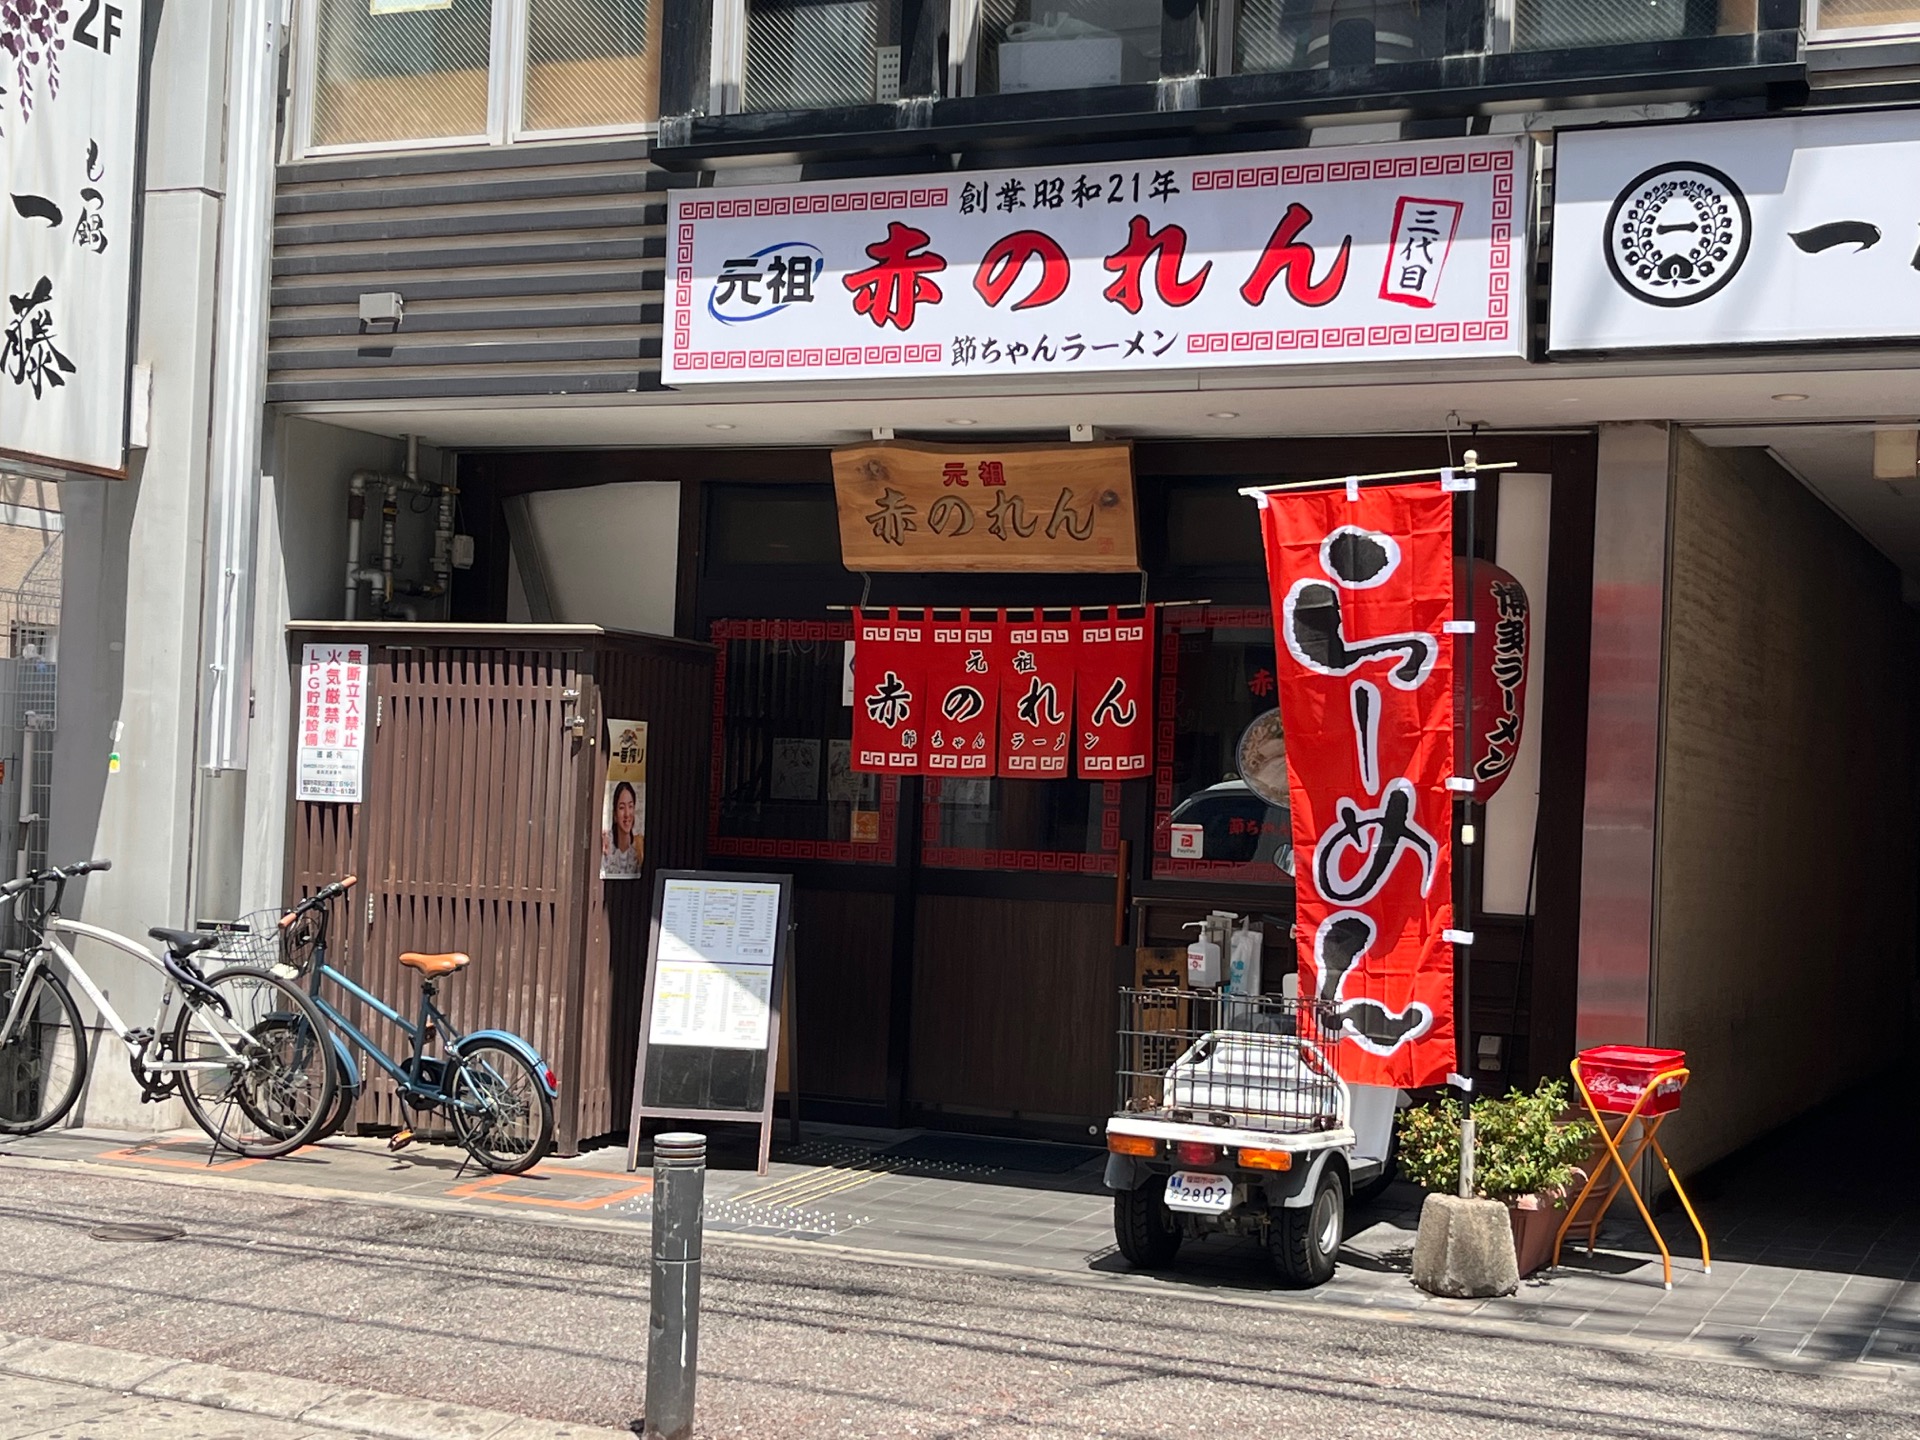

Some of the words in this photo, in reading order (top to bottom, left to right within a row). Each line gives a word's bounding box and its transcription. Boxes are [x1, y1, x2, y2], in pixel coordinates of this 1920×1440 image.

[73, 0, 122, 55] 2F
[958, 170, 1181, 214] 創業昭和21年
[844, 203, 1351, 331] 赤のれん
[1400, 209, 1439, 292] 三代目
[1, 192, 76, 400] 一藤
[715, 255, 818, 305] 元祖
[951, 330, 1179, 367] 節ちゃんラーメン
[942, 461, 1007, 487] 元祖
[865, 487, 1096, 547] 赤のれん
[324, 649, 342, 724] 火気厳禁
[965, 650, 1037, 673] 元祖
[304, 649, 320, 747] LPG貯蔵設備
[343, 650, 362, 748] 無断立入禁止
[865, 672, 1137, 728] 赤のれん
[901, 729, 1100, 750] 節ちゃんラーメン
[1283, 525, 1439, 1056] らーめん
[1181, 1186, 1227, 1205] 2802
